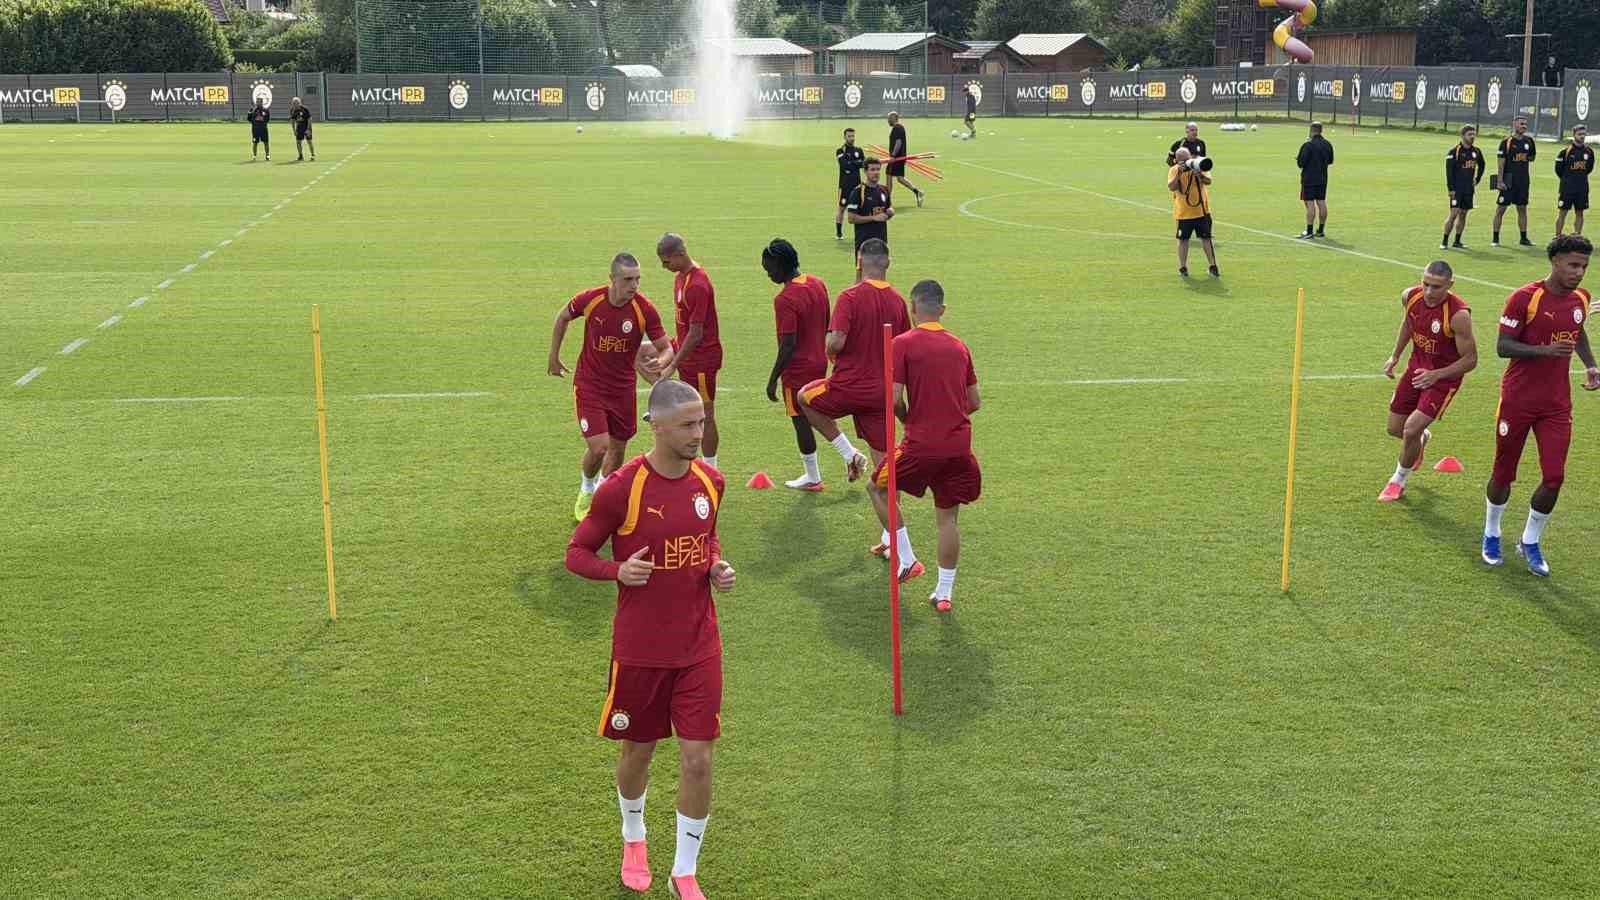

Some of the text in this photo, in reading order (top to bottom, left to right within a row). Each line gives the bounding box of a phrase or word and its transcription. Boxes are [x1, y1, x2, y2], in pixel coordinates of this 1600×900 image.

[599, 335, 631, 346] NEXT
[664, 533, 709, 553] NEXT
[651, 551, 708, 570] LEVEL
